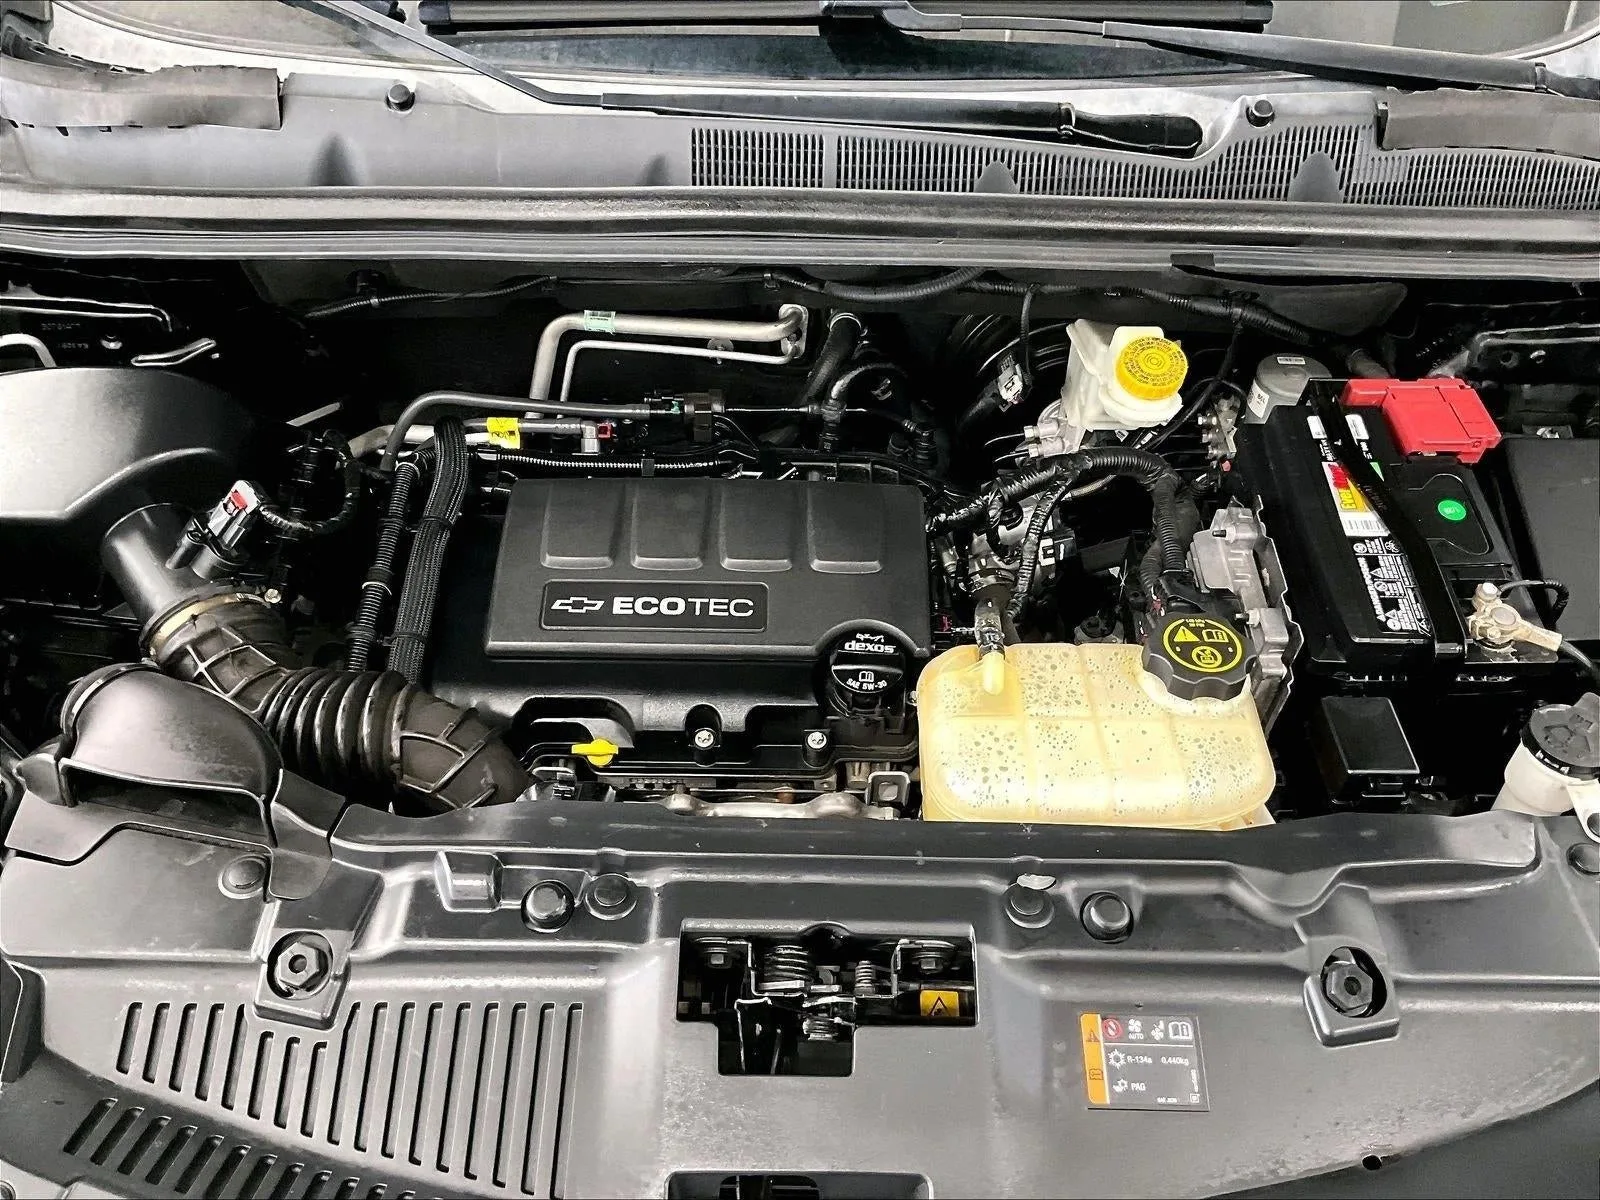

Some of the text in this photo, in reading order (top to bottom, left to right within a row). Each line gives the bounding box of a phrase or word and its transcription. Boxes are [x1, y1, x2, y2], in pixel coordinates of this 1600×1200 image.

[612, 596, 755, 618] ECOTEC
[844, 640, 896, 654] dexos
[846, 678, 888, 691] SAE 5W-30
[1126, 1055, 1153, 1065] R-134a
[1131, 1082, 1146, 1092] PAG
